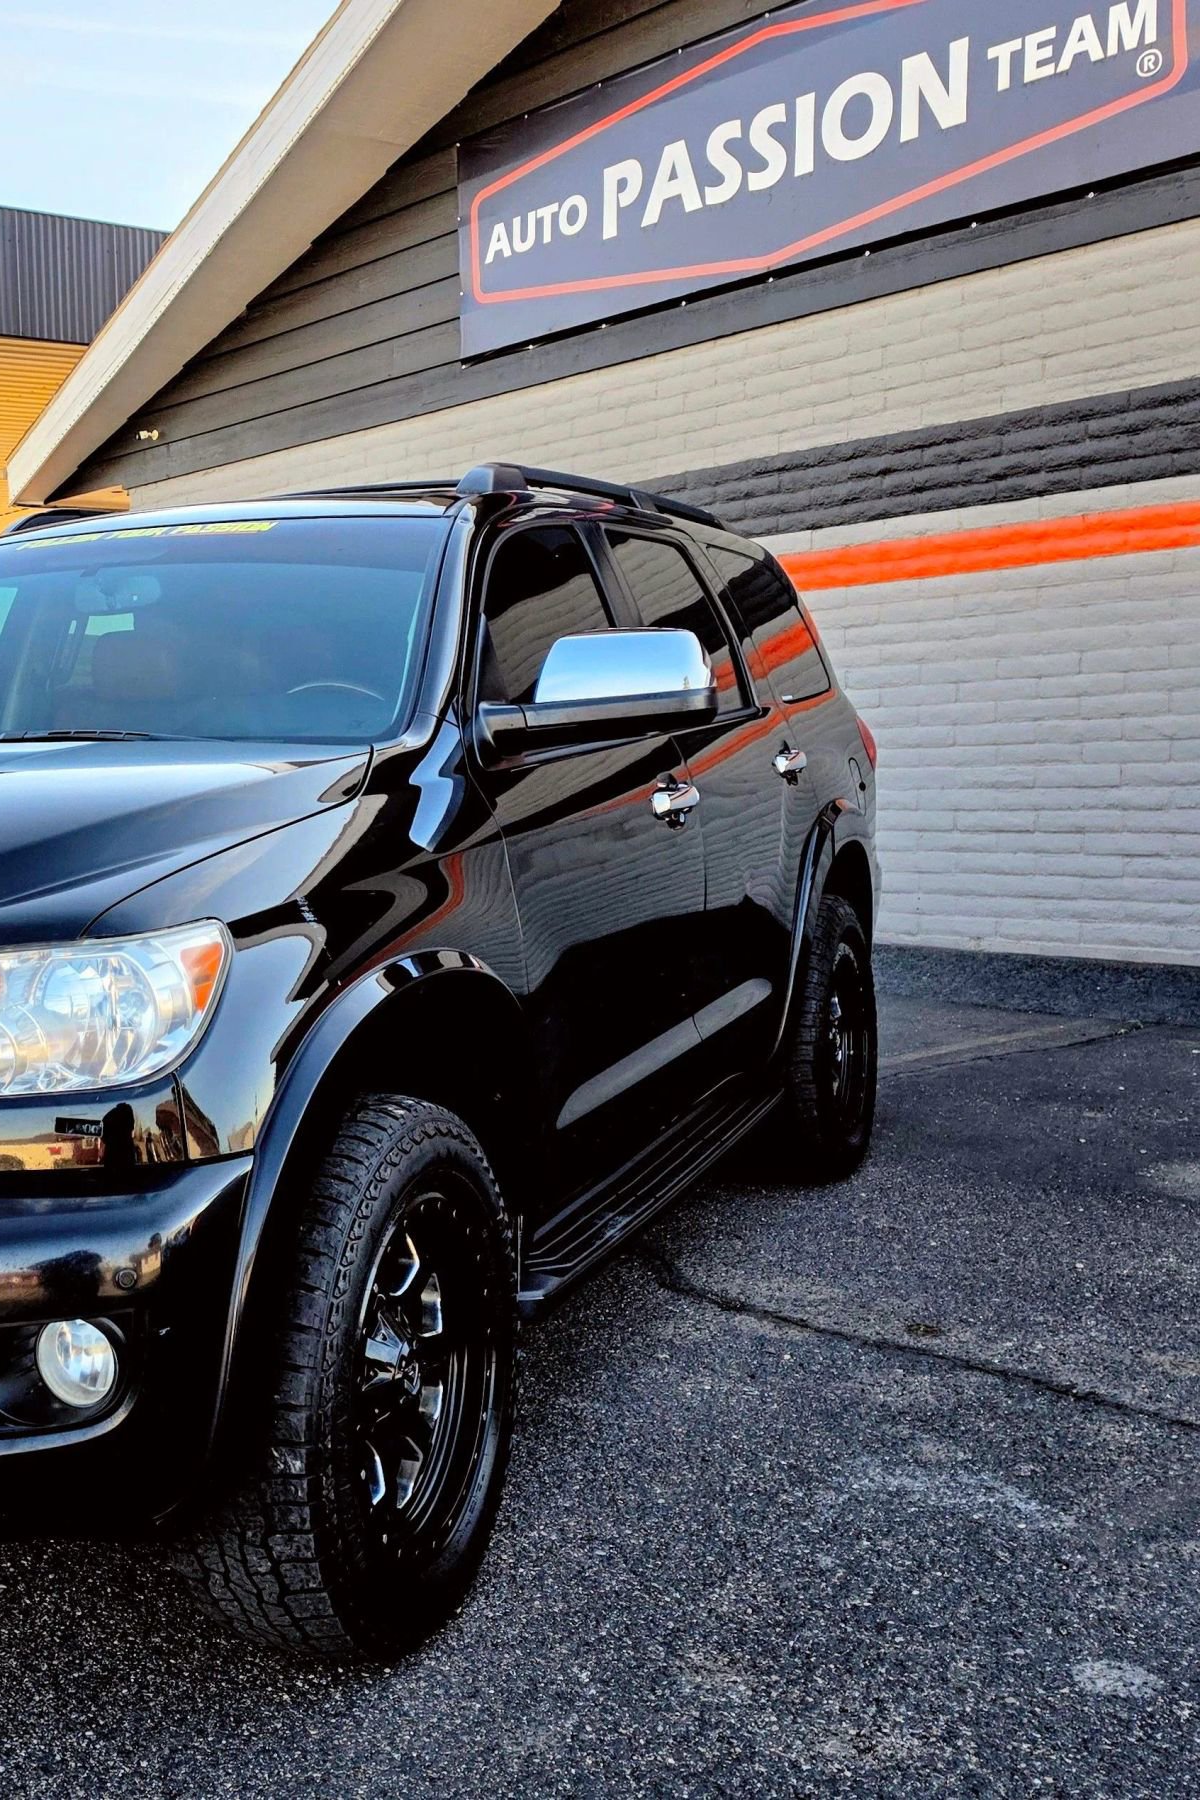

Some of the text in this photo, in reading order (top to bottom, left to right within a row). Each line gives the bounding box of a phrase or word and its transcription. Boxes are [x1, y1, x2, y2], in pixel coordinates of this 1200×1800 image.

[484, 194, 588, 265] AUTO
[602, 36, 970, 241] PASSION
[987, 0, 1158, 92] TEAM
